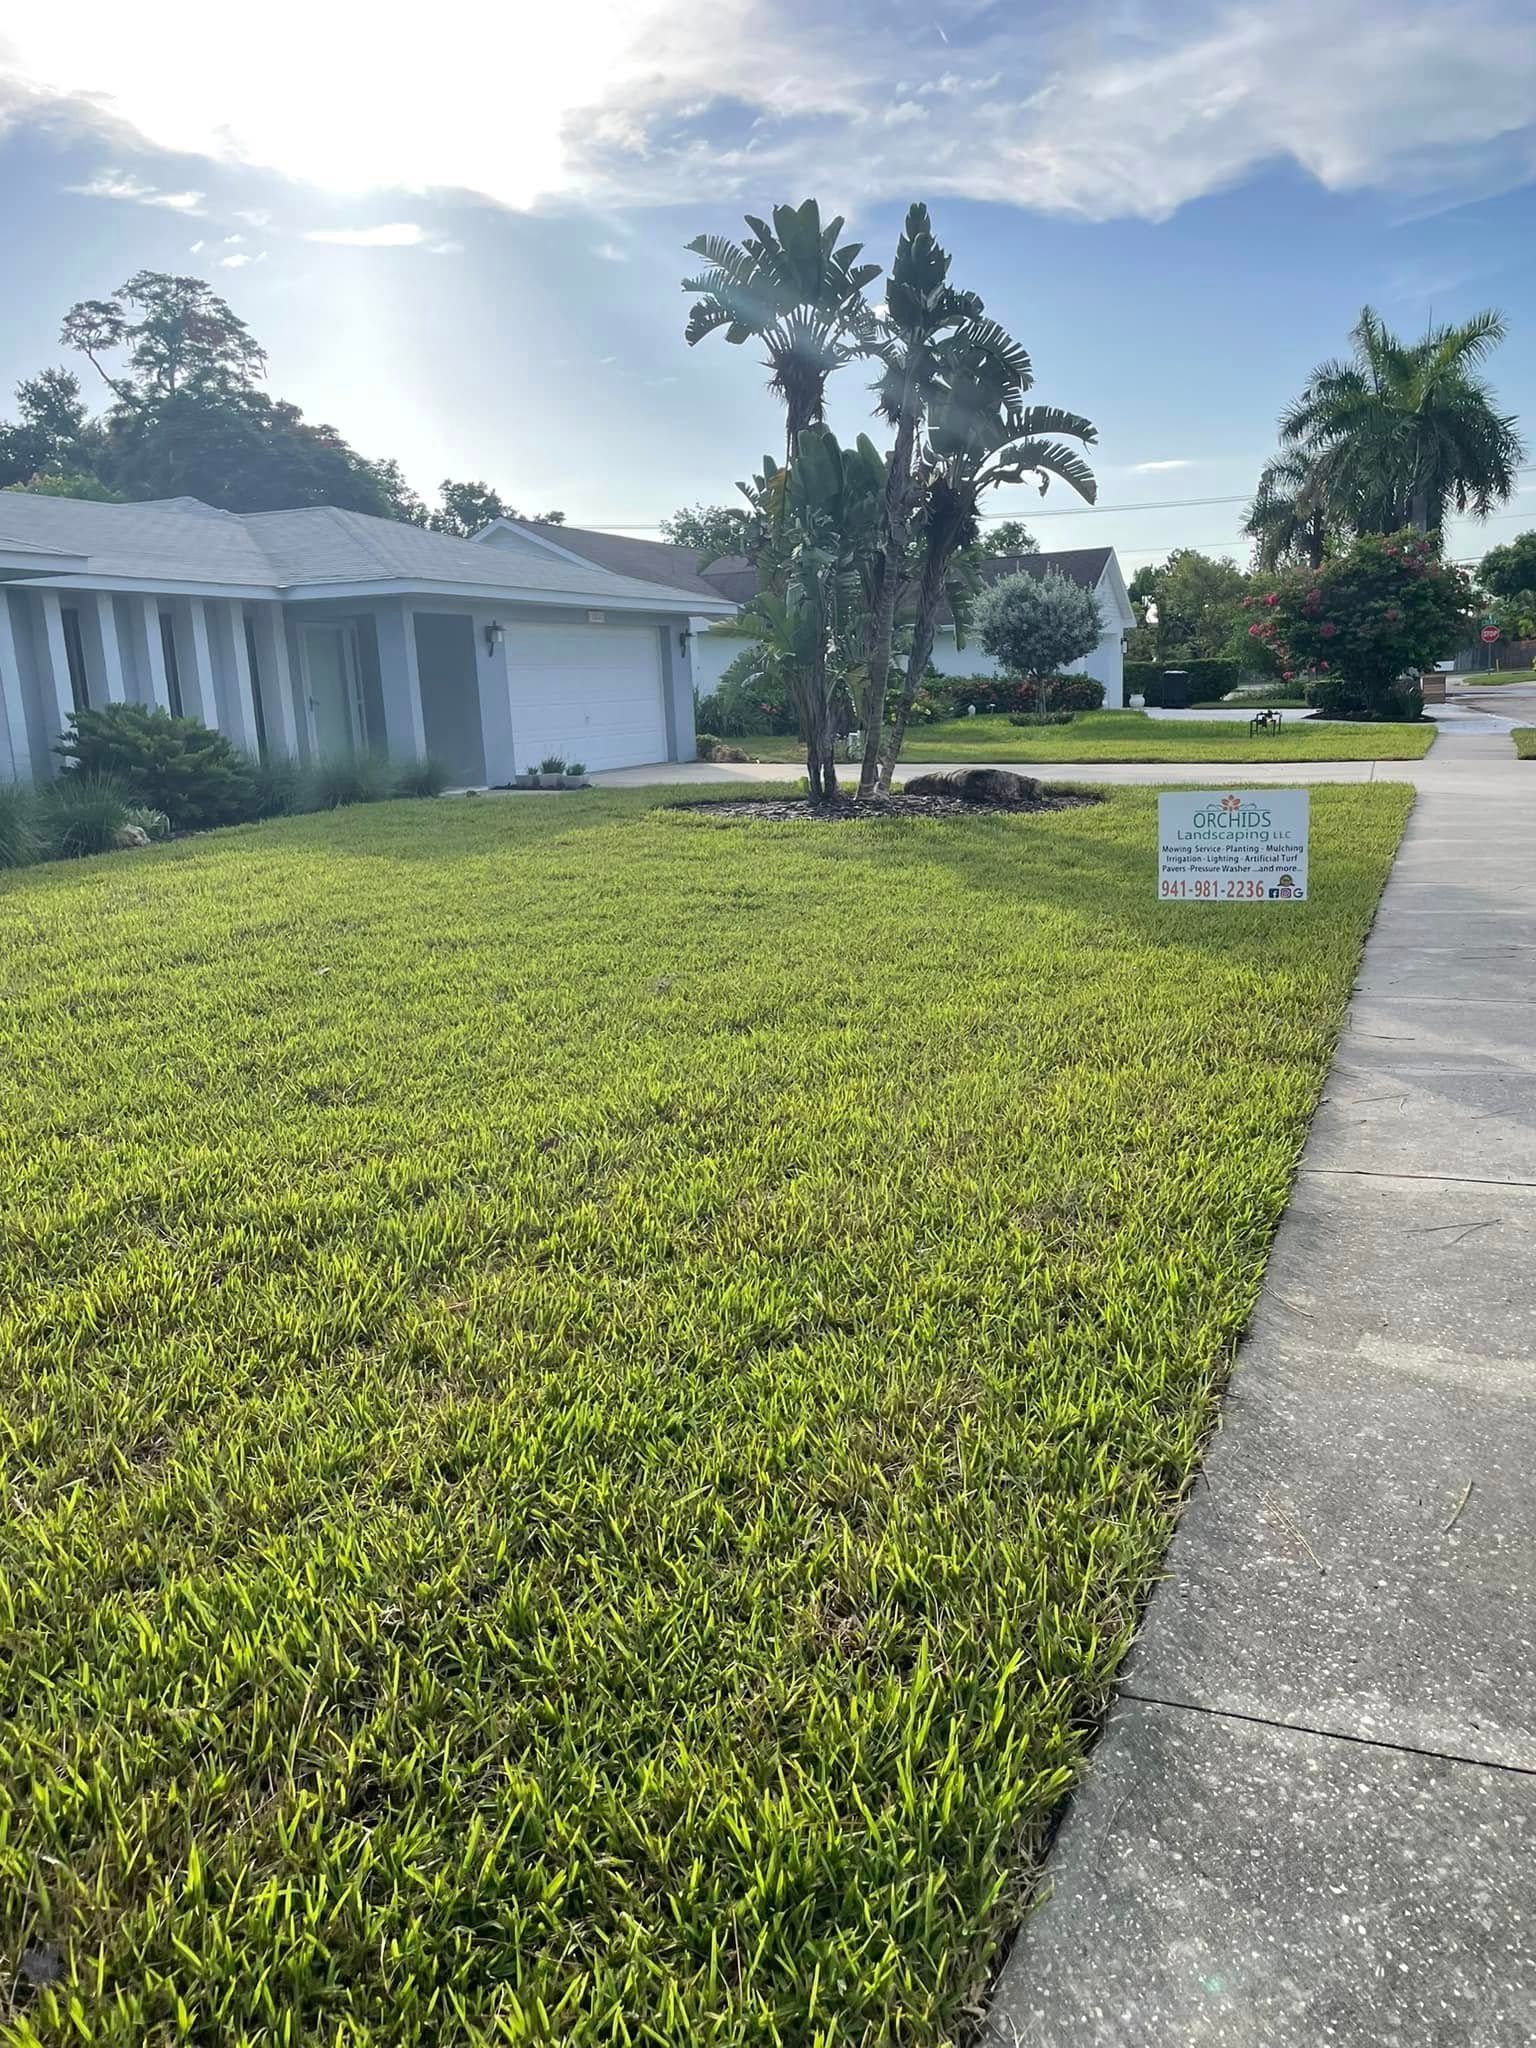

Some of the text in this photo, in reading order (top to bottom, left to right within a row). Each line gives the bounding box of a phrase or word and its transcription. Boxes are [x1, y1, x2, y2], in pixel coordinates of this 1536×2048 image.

[1193, 811, 1272, 828] ORCHIDS
[1177, 829, 1292, 842] Landscaping LLC
[1162, 844, 1304, 854] Mowing Service Planting Mulching
[1166, 854, 1298, 864] Irrigation Lighting Artificial Turf
[1162, 865, 1186, 873] Pavers
[1222, 865, 1251, 873] Washer
[1162, 879, 1265, 898] 941-981-2236
